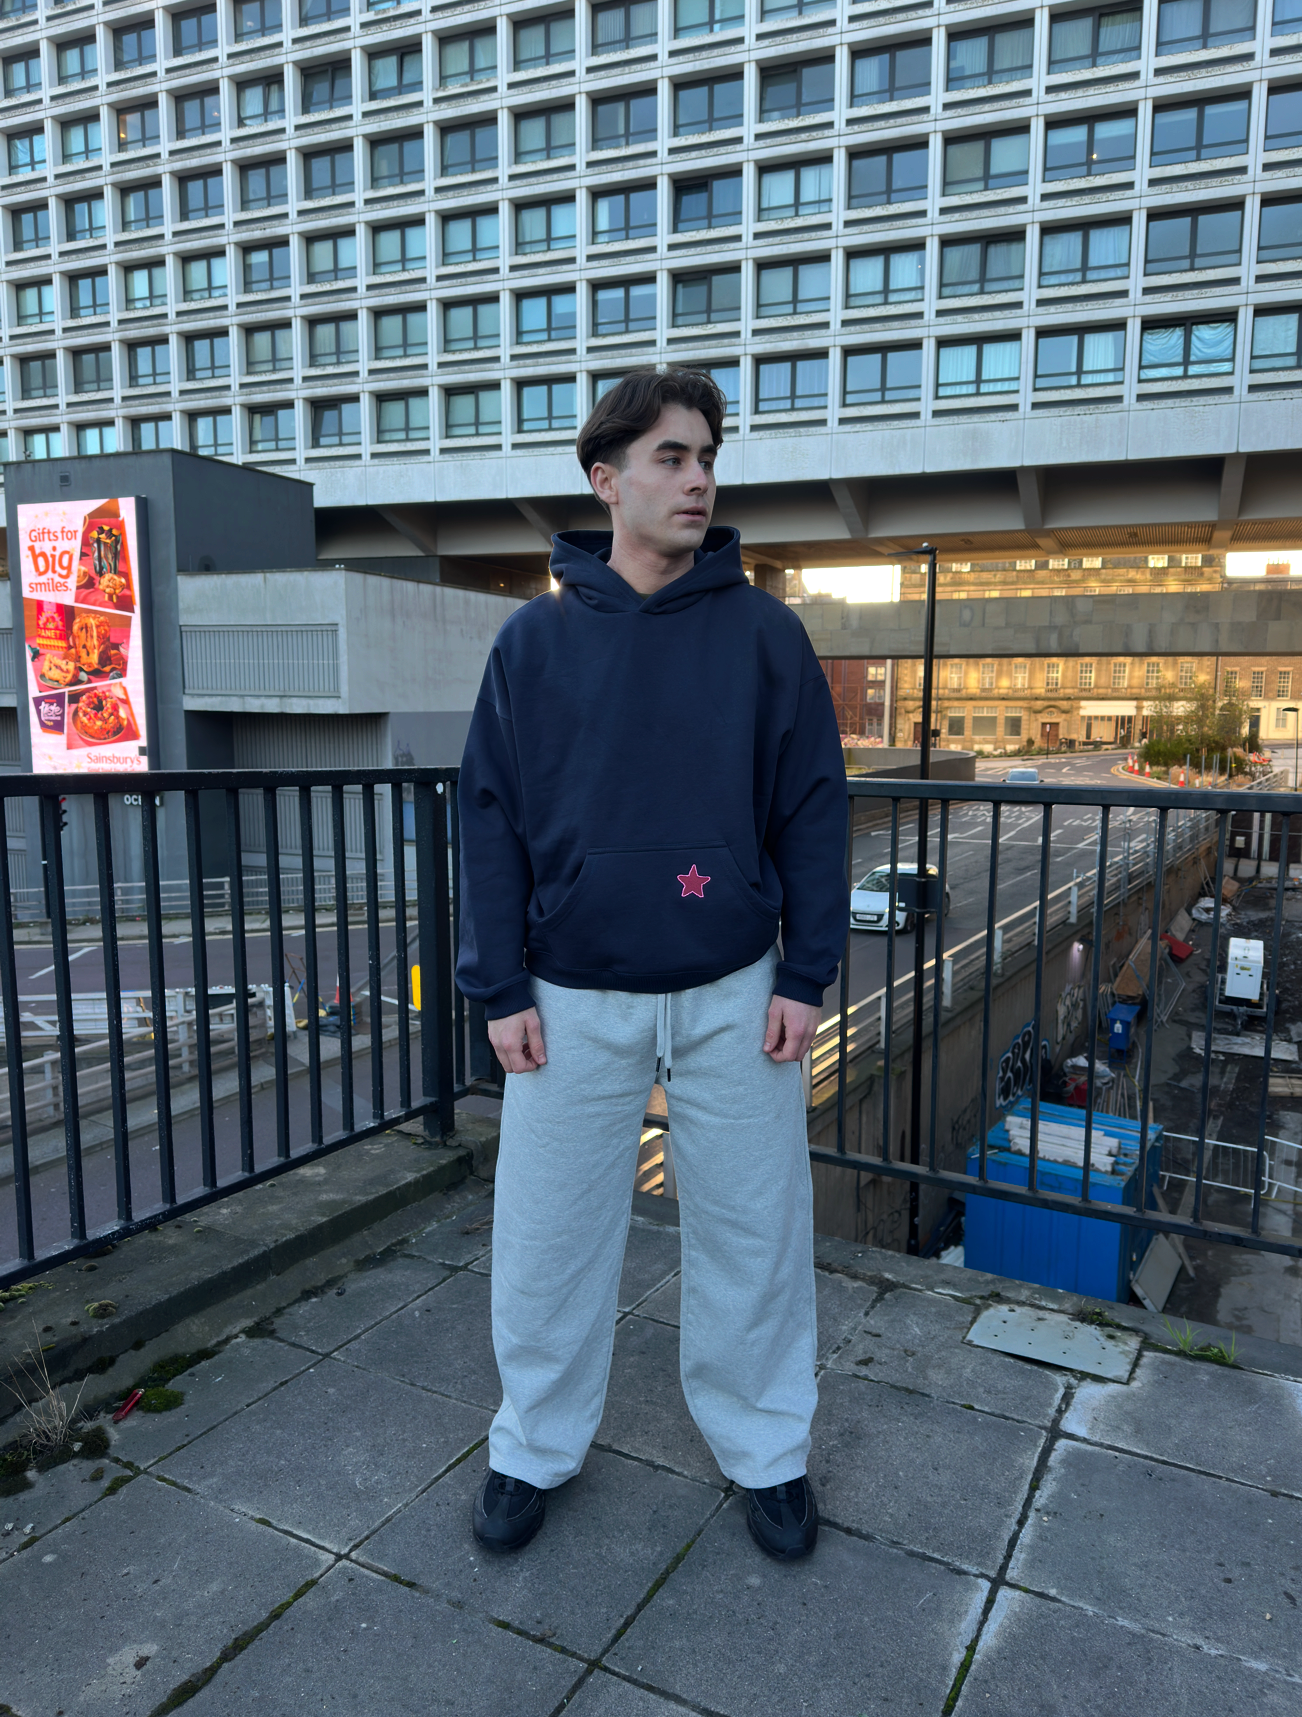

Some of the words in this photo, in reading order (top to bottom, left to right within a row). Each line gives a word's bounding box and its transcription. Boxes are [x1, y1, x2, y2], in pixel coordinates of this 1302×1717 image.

[28, 527, 59, 543] Gifts
[60, 526, 78, 541] for
[27, 544, 74, 579] big
[28, 577, 72, 593] smiles.
[86, 752, 142, 768] Sainsbury's
[124, 794, 160, 806] OCN
